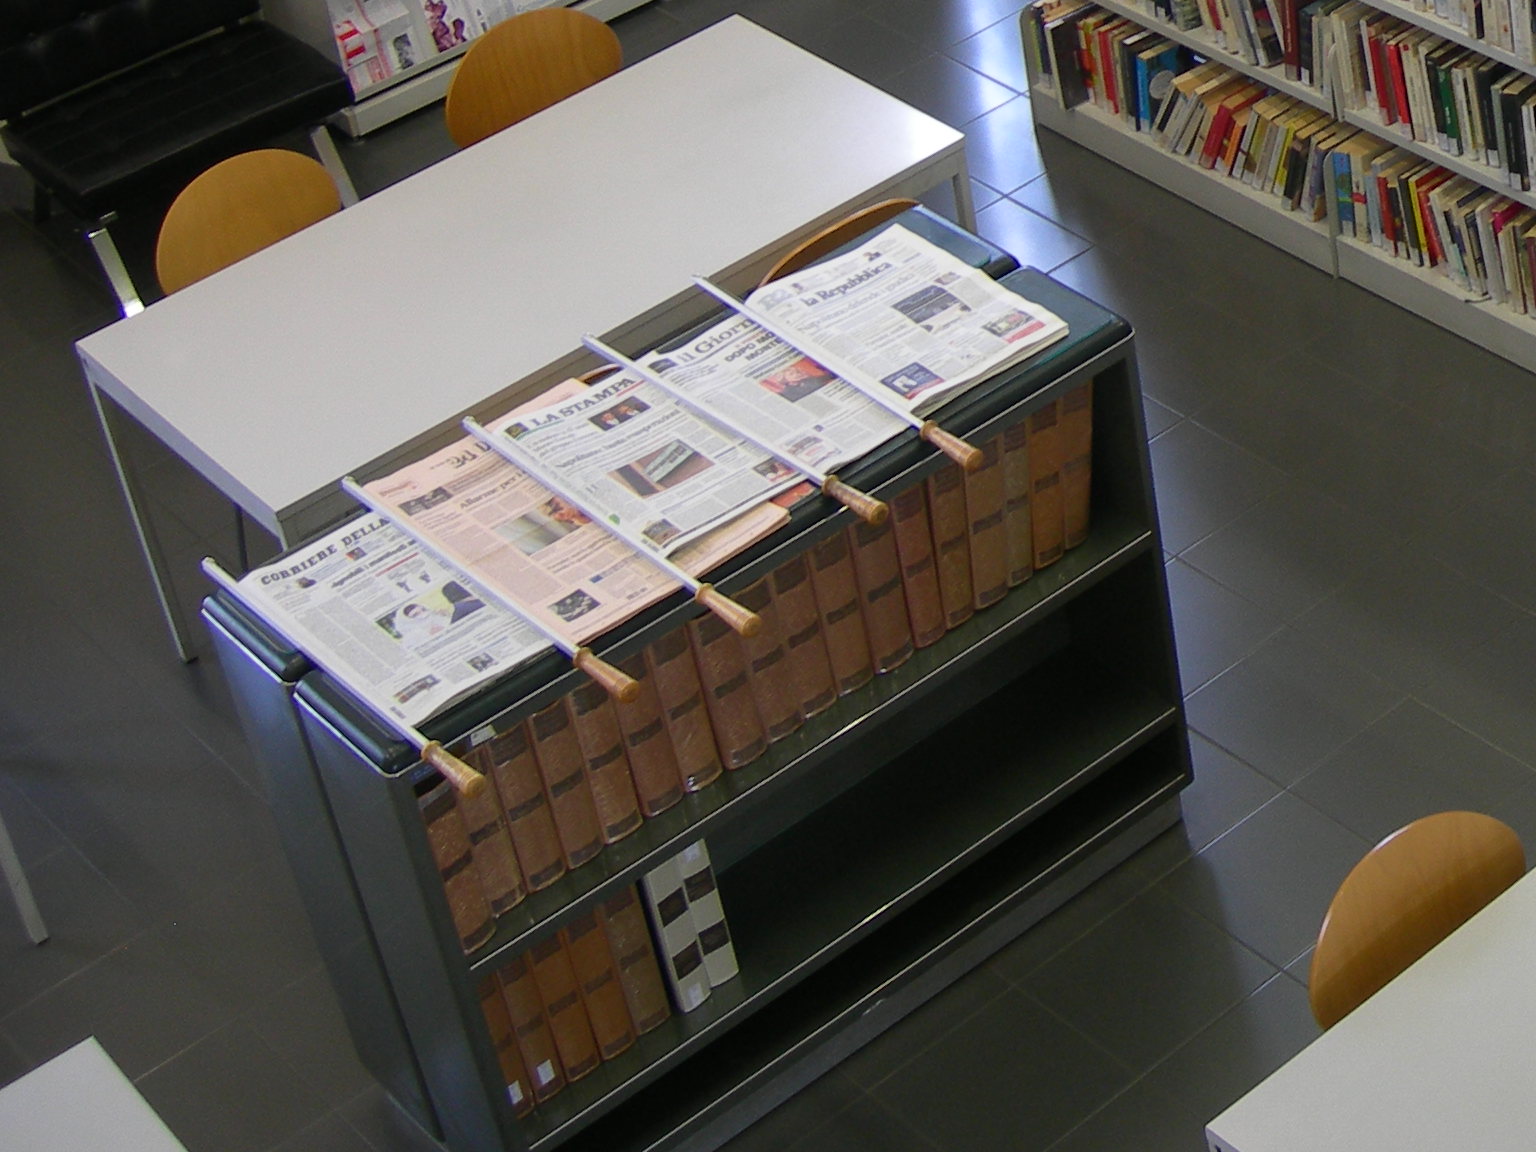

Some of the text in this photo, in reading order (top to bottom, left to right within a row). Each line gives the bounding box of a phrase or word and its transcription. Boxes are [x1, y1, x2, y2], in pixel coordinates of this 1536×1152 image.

[820, 260, 894, 302] Repubblica
[724, 342, 758, 363] DOPO
[531, 376, 637, 429] LA STAMPA
[459, 486, 498, 510] Allarme
[261, 543, 337, 587] CORRIERE
[341, 517, 391, 546] DELLA
